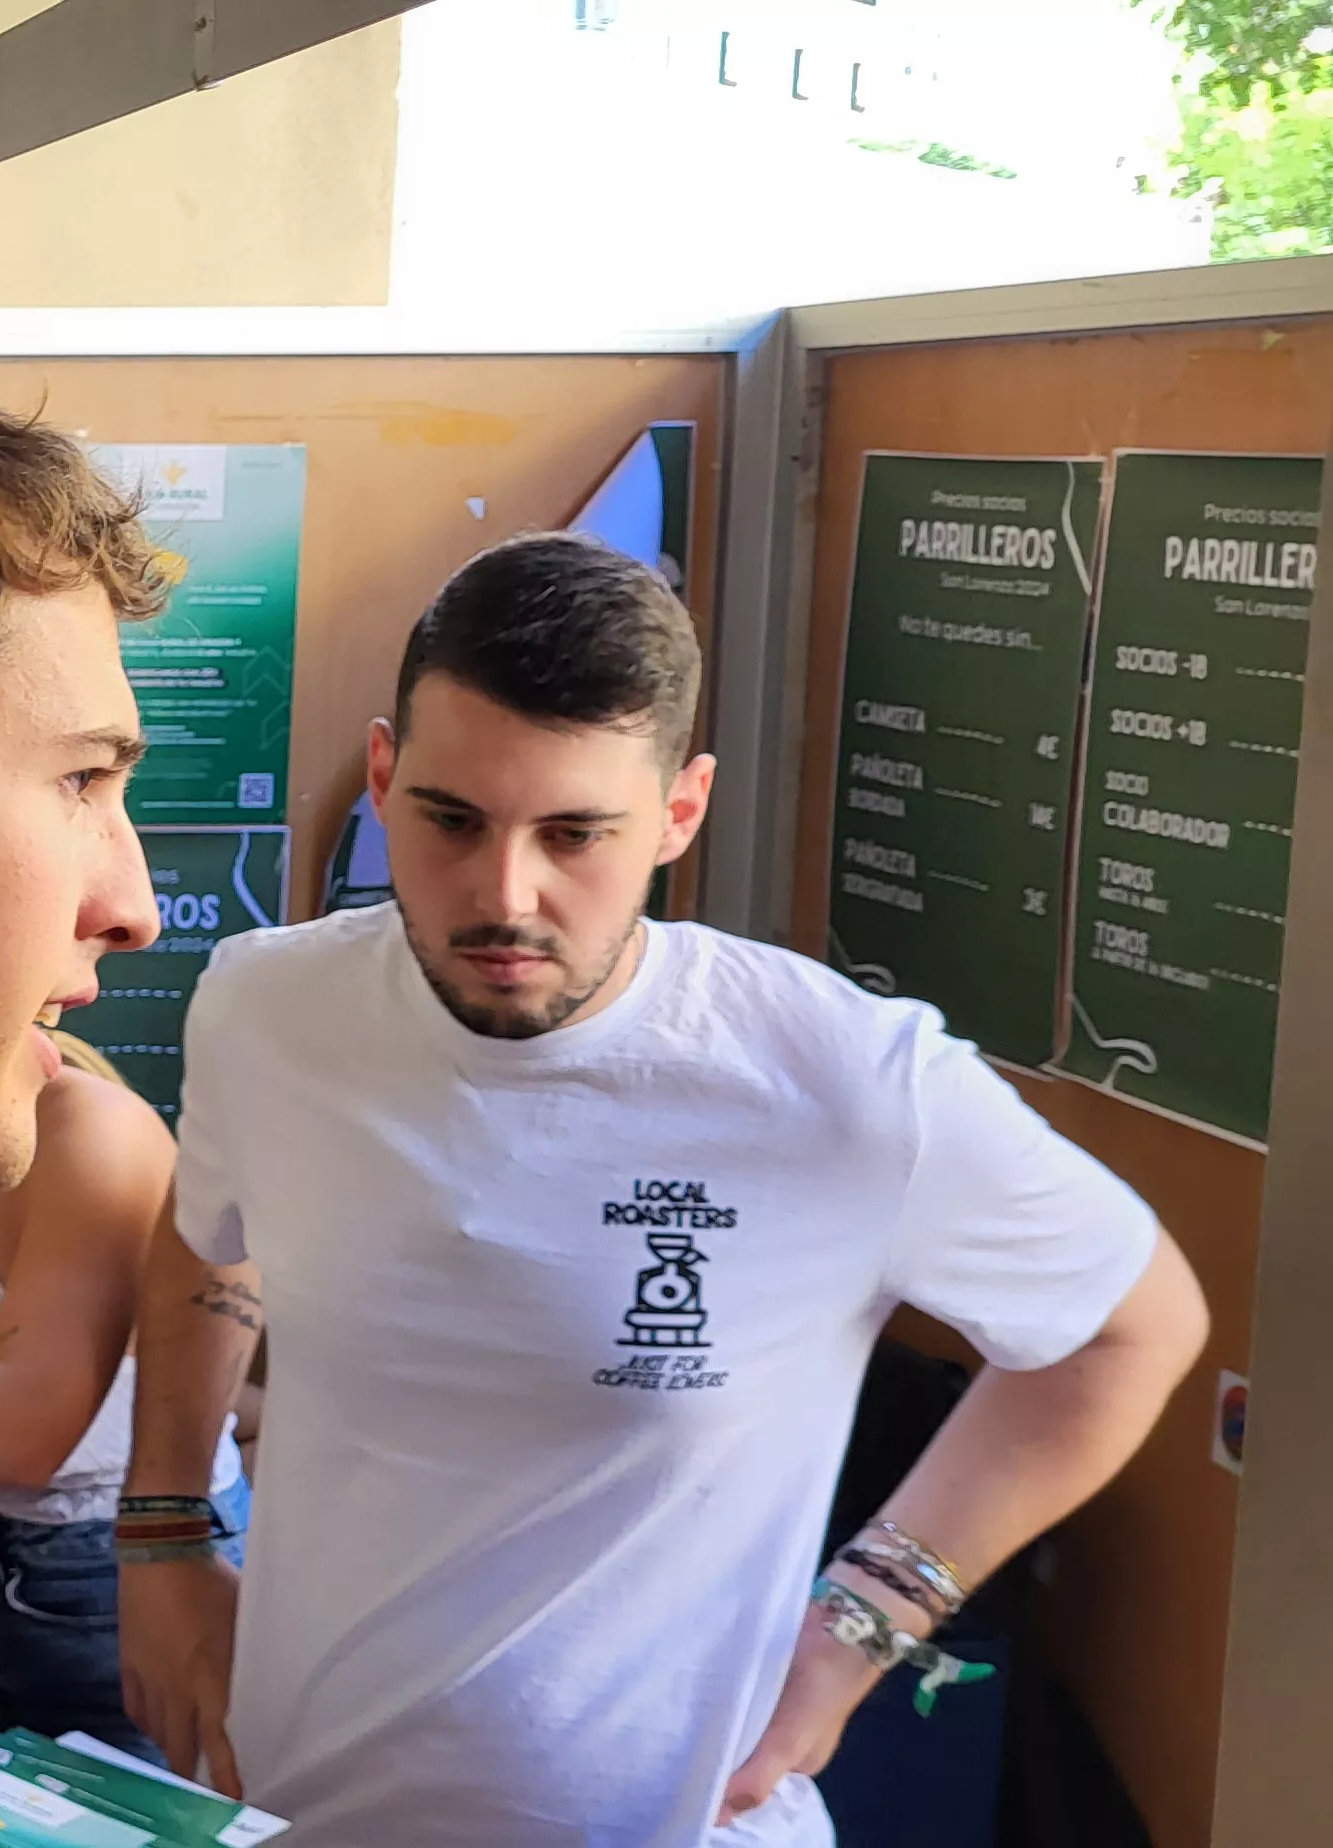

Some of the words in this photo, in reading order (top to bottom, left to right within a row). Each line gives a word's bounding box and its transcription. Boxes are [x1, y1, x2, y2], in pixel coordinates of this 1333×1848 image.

[1205, 505, 1264, 524] Precios
[900, 519, 1056, 569] PARRILLEROS
[1215, 596, 1243, 613] San
[943, 622, 1001, 645] quedes
[1116, 646, 1177, 676] SOCIOS
[1111, 709, 1173, 740] SOCIOS
[1103, 801, 1230, 849] COLABORADOR
[1099, 857, 1154, 892] TOROS
[1094, 920, 1149, 956] TOROS
[635, 1178, 709, 1203] LOCAL
[602, 1202, 738, 1229] ROASTERS
